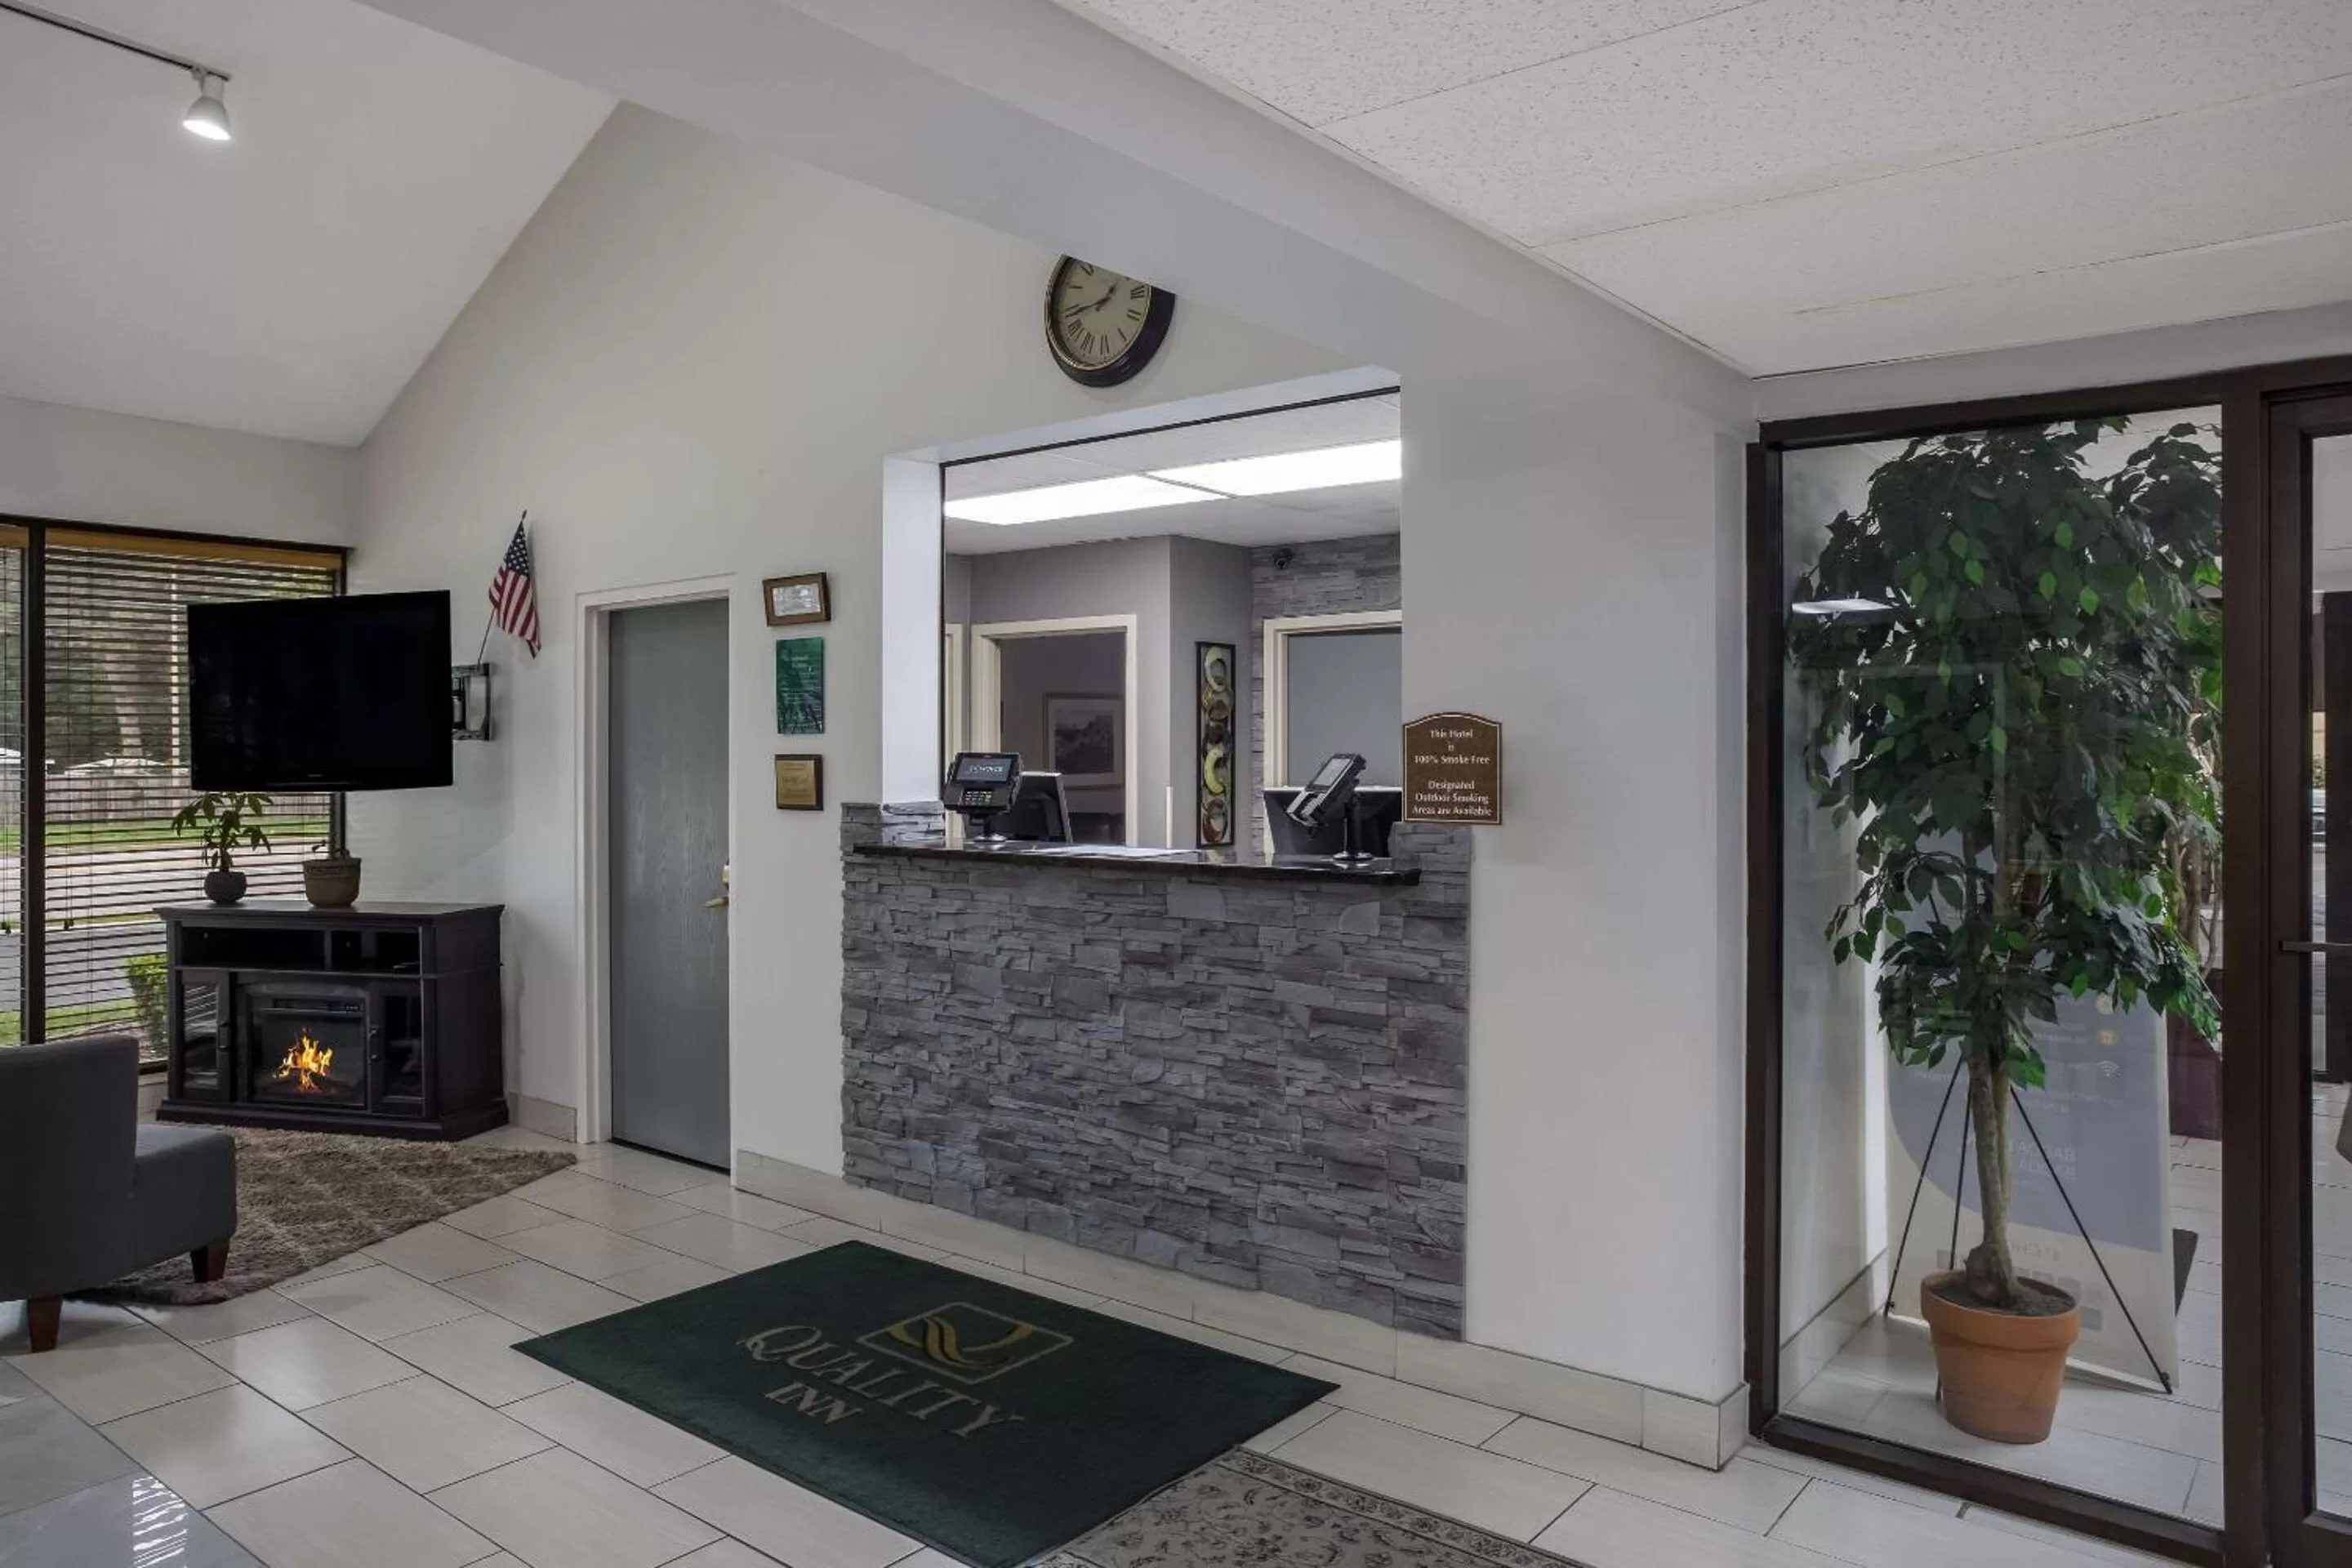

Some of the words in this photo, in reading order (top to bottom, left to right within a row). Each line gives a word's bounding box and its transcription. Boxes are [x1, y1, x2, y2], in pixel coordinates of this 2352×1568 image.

[1430, 728, 1447, 738] This
[1450, 728, 1473, 738] Hotel
[1414, 755, 1439, 764] 100%
[1441, 754, 1470, 764] Smoke
[1472, 755, 1491, 764] Free
[1428, 780, 1475, 792] Designated
[1415, 793, 1450, 802] Outdoor
[1453, 793, 1490, 804] Smoking
[1412, 804, 1436, 814] Areas
[1437, 806, 1451, 814] are
[1453, 805, 1493, 817] Available
[737, 1325, 1026, 1437] QUALITY
[764, 1380, 863, 1425] INN
